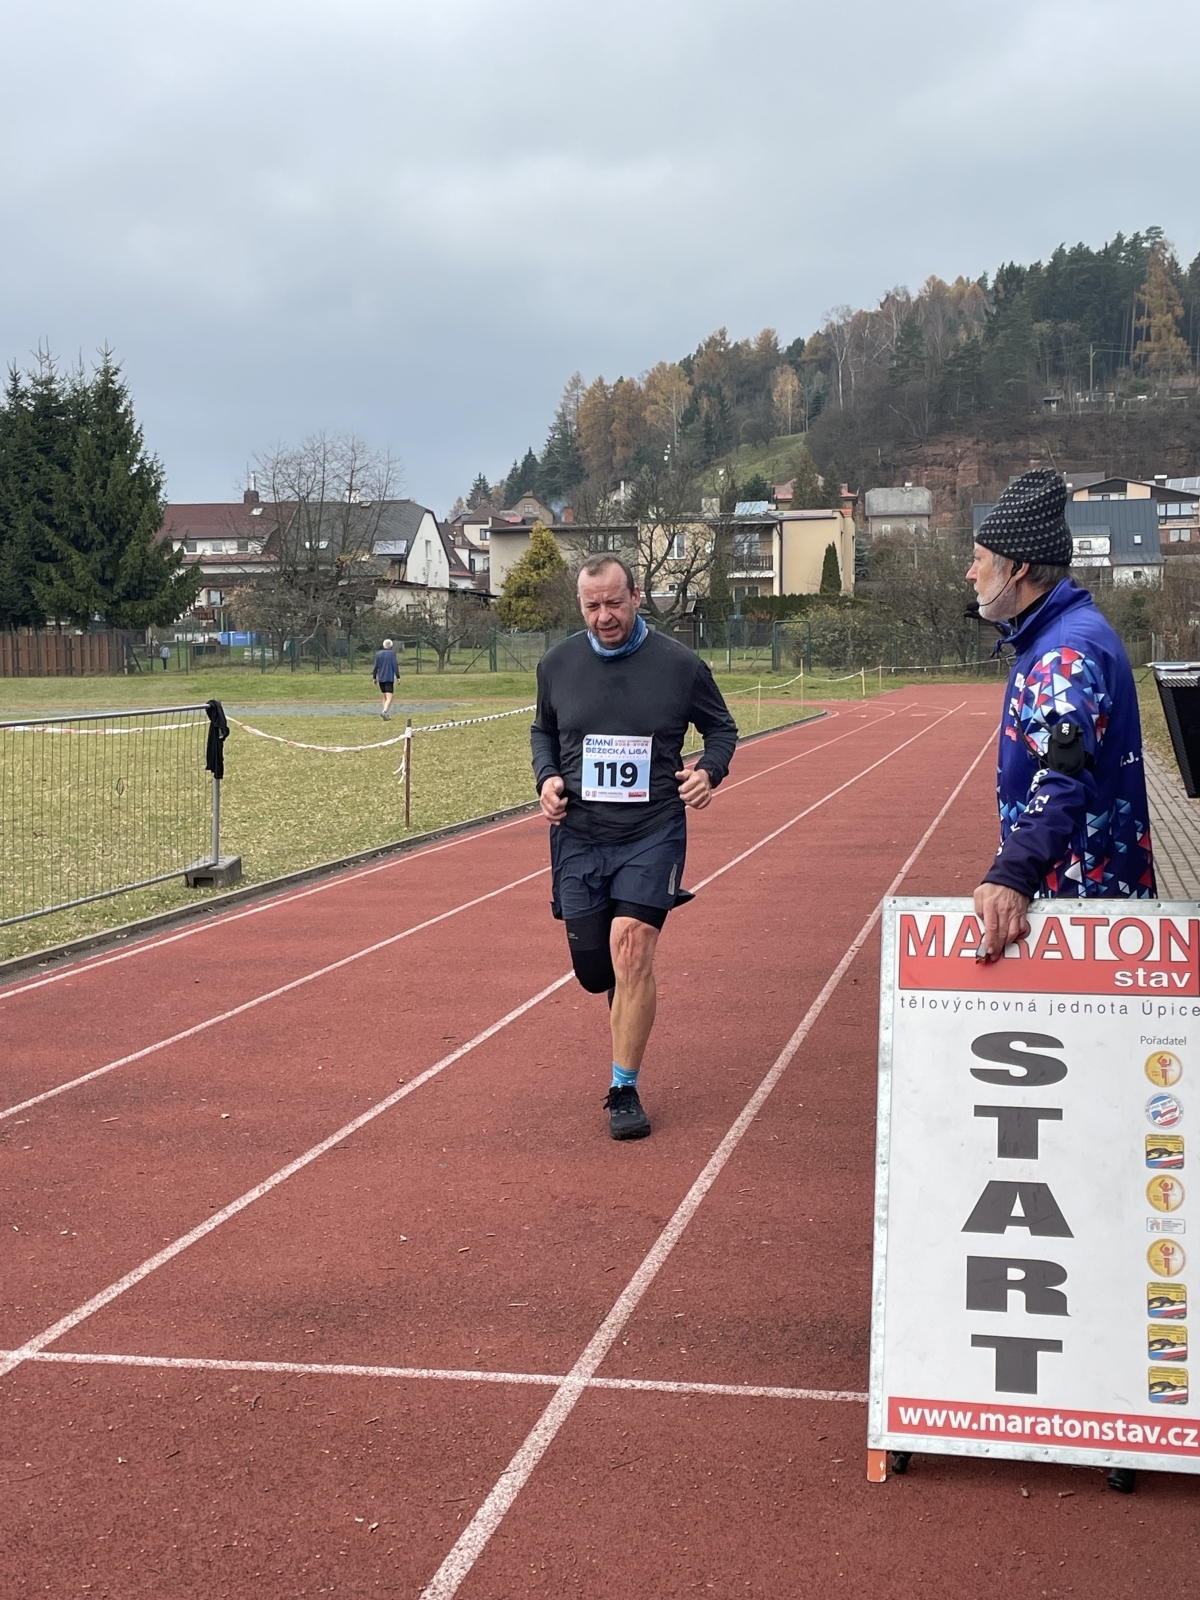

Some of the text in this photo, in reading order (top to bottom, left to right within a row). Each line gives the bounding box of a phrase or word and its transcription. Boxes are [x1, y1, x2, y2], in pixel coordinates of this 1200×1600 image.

[585, 738, 614, 747] ZIMNÍ
[1120, 751, 1139, 767] .J.
[594, 762, 638, 788] 119
[1113, 967, 1192, 989] stav
[900, 996, 1200, 1018] tělovýchovná jednota Úpice
[1140, 1035, 1187, 1046] Pořadatel
[960, 1031, 1075, 1395] START
[898, 1405, 1199, 1448] www.maratonstav.cz
